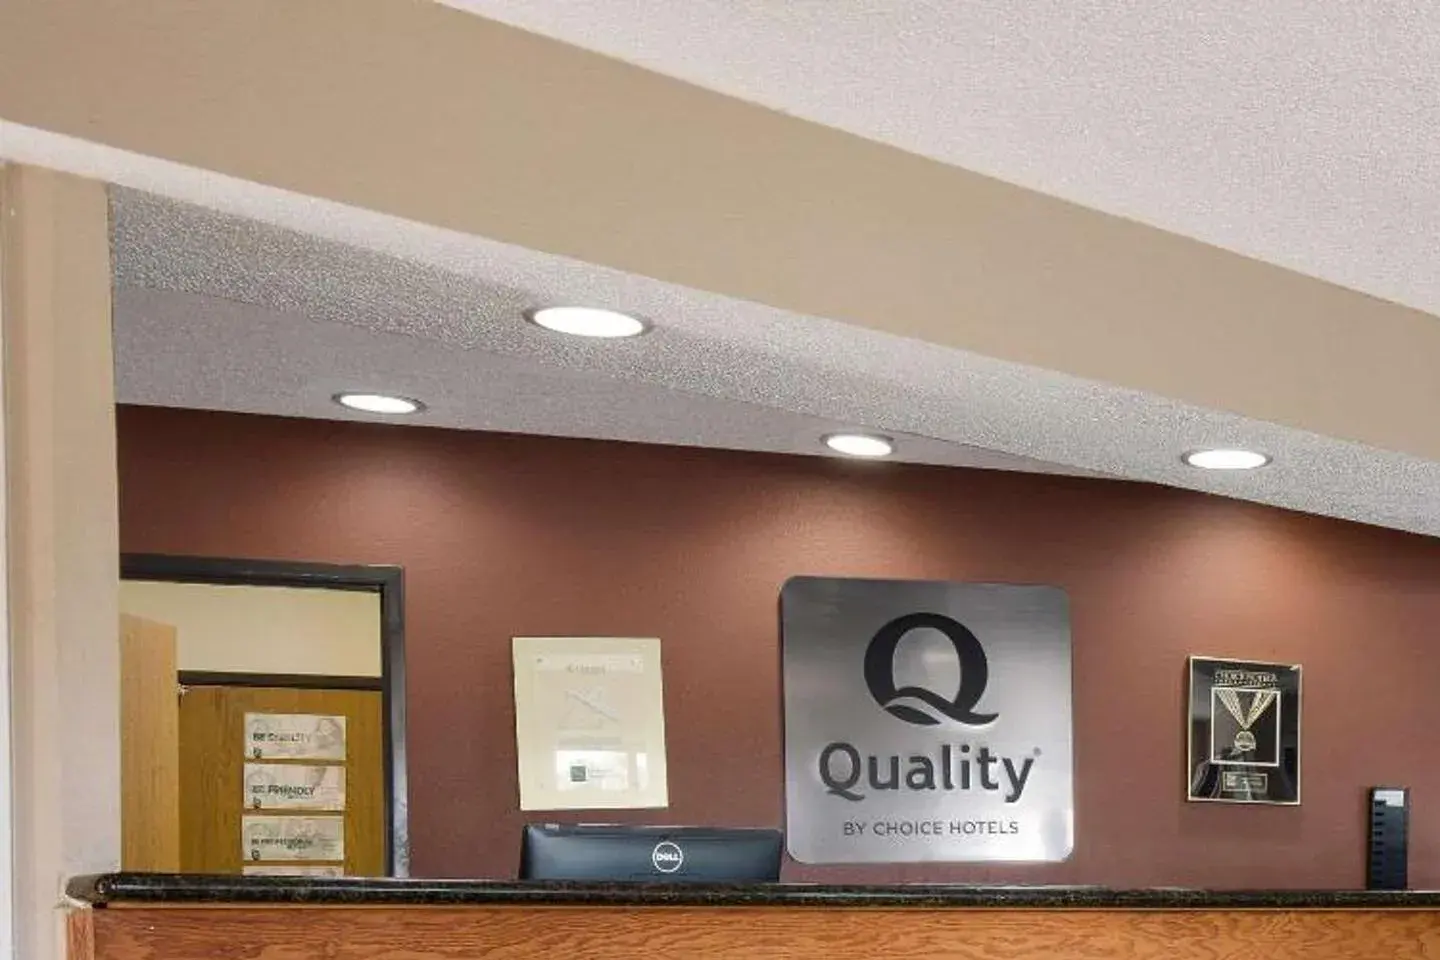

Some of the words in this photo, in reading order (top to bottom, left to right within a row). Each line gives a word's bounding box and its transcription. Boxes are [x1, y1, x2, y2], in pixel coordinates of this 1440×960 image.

[864, 612, 999, 726] Q
[819, 742, 1034, 803] Quality
[843, 821, 867, 836] BY
[872, 821, 943, 836] CHOICE
[948, 821, 1019, 835] HOTELS
